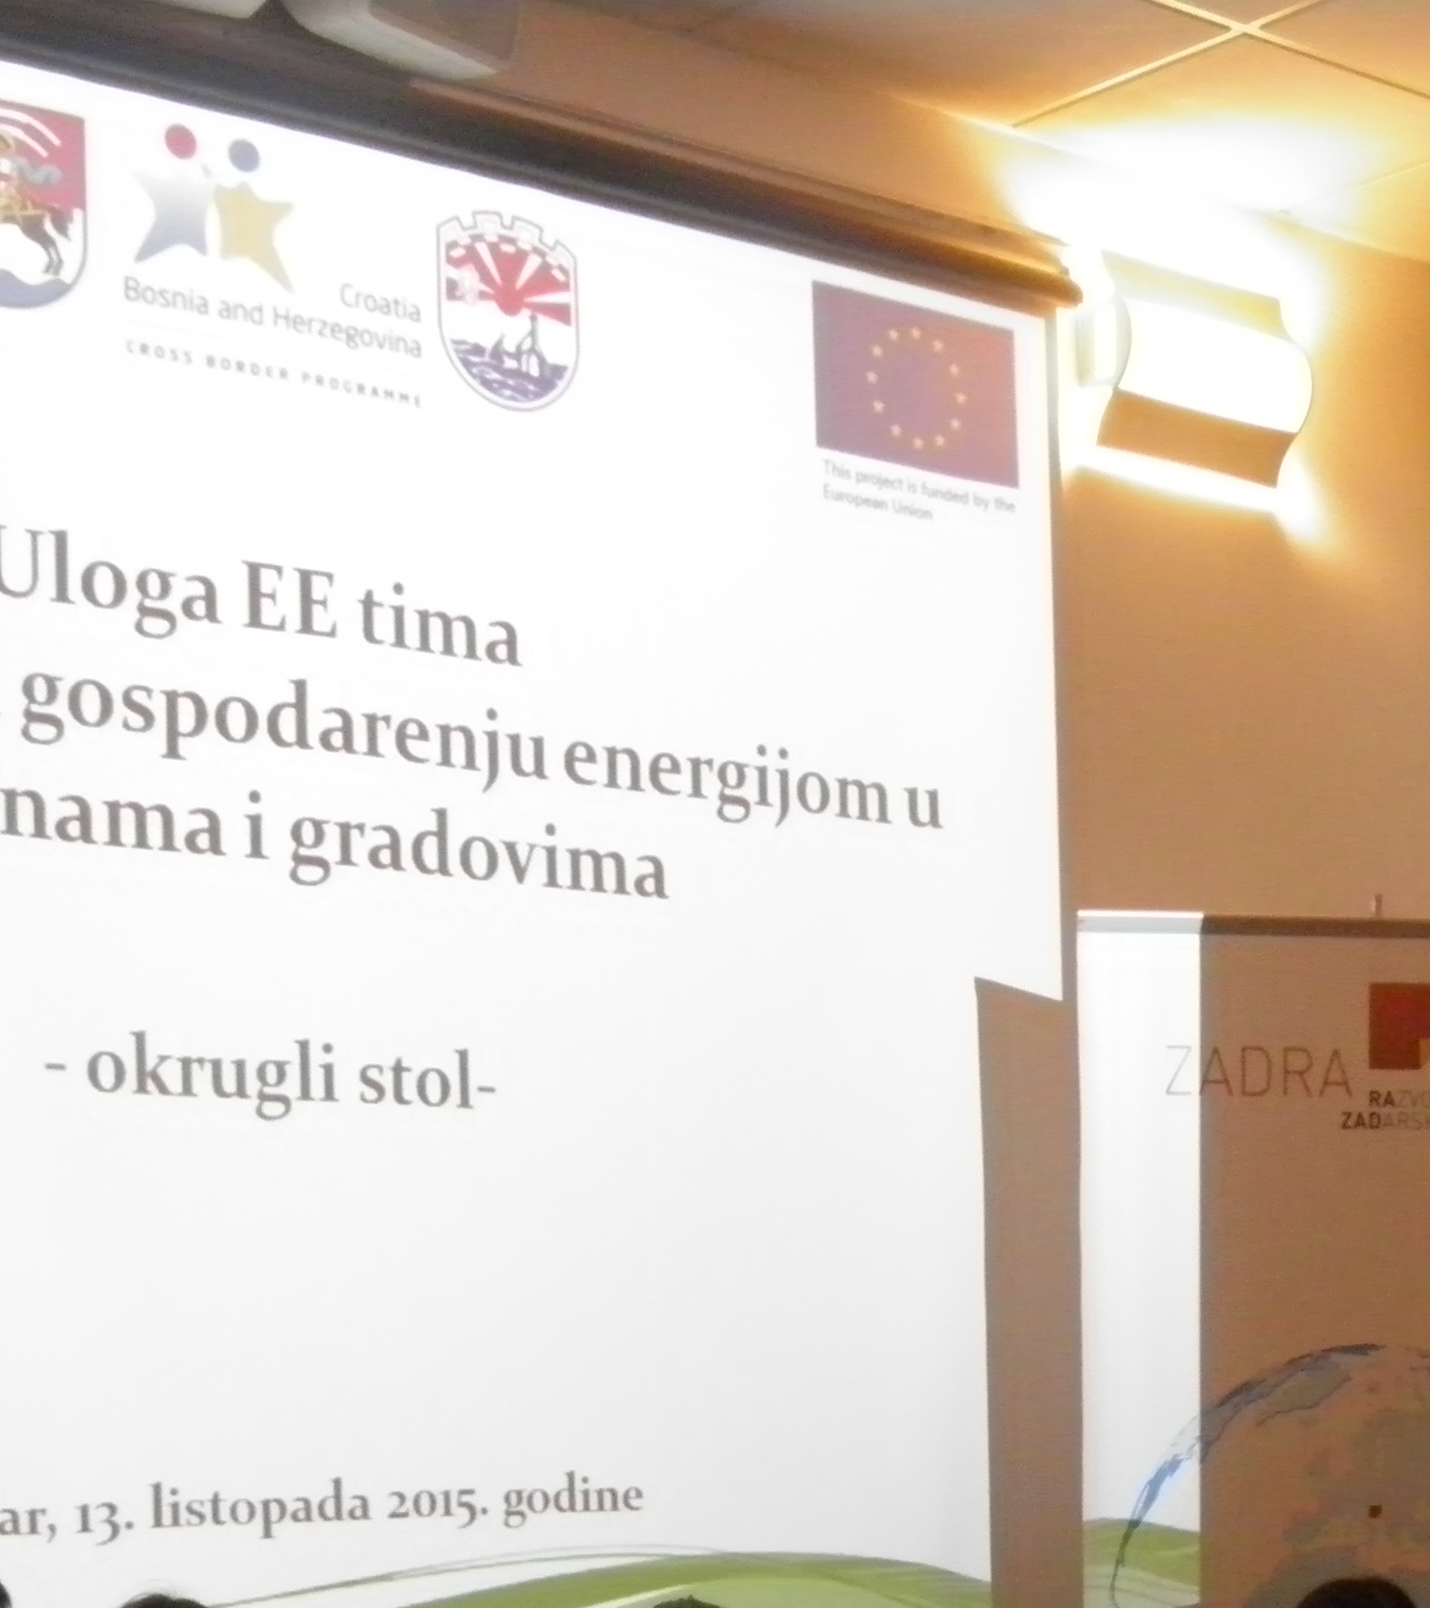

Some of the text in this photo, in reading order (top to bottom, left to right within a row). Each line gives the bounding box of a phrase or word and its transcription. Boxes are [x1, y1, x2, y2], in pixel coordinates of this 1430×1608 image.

[124, 275, 422, 358] Bosnia and Herzegovina
[340, 282, 422, 322] Croatia
[126, 339, 193, 364] CROSS
[205, 355, 289, 381] BORDER
[823, 459, 1016, 514] This project is funded by the
[823, 485, 933, 521] European Union
[240, 560, 338, 638] EE
[357, 583, 522, 667] tima
[21, 670, 547, 792] gospodarenju
[563, 738, 893, 828] energijom
[904, 785, 944, 830] u
[243, 790, 269, 860] i
[288, 808, 670, 900] gradovima
[86, 1029, 340, 1121] okrugli
[1164, 1044, 1354, 1098] ZADRA
[75, 1502, 134, 1546] 13.
[150, 1477, 371, 1540] listopada
[387, 1487, 489, 1530] 2015.
[502, 1470, 645, 1528] godine
